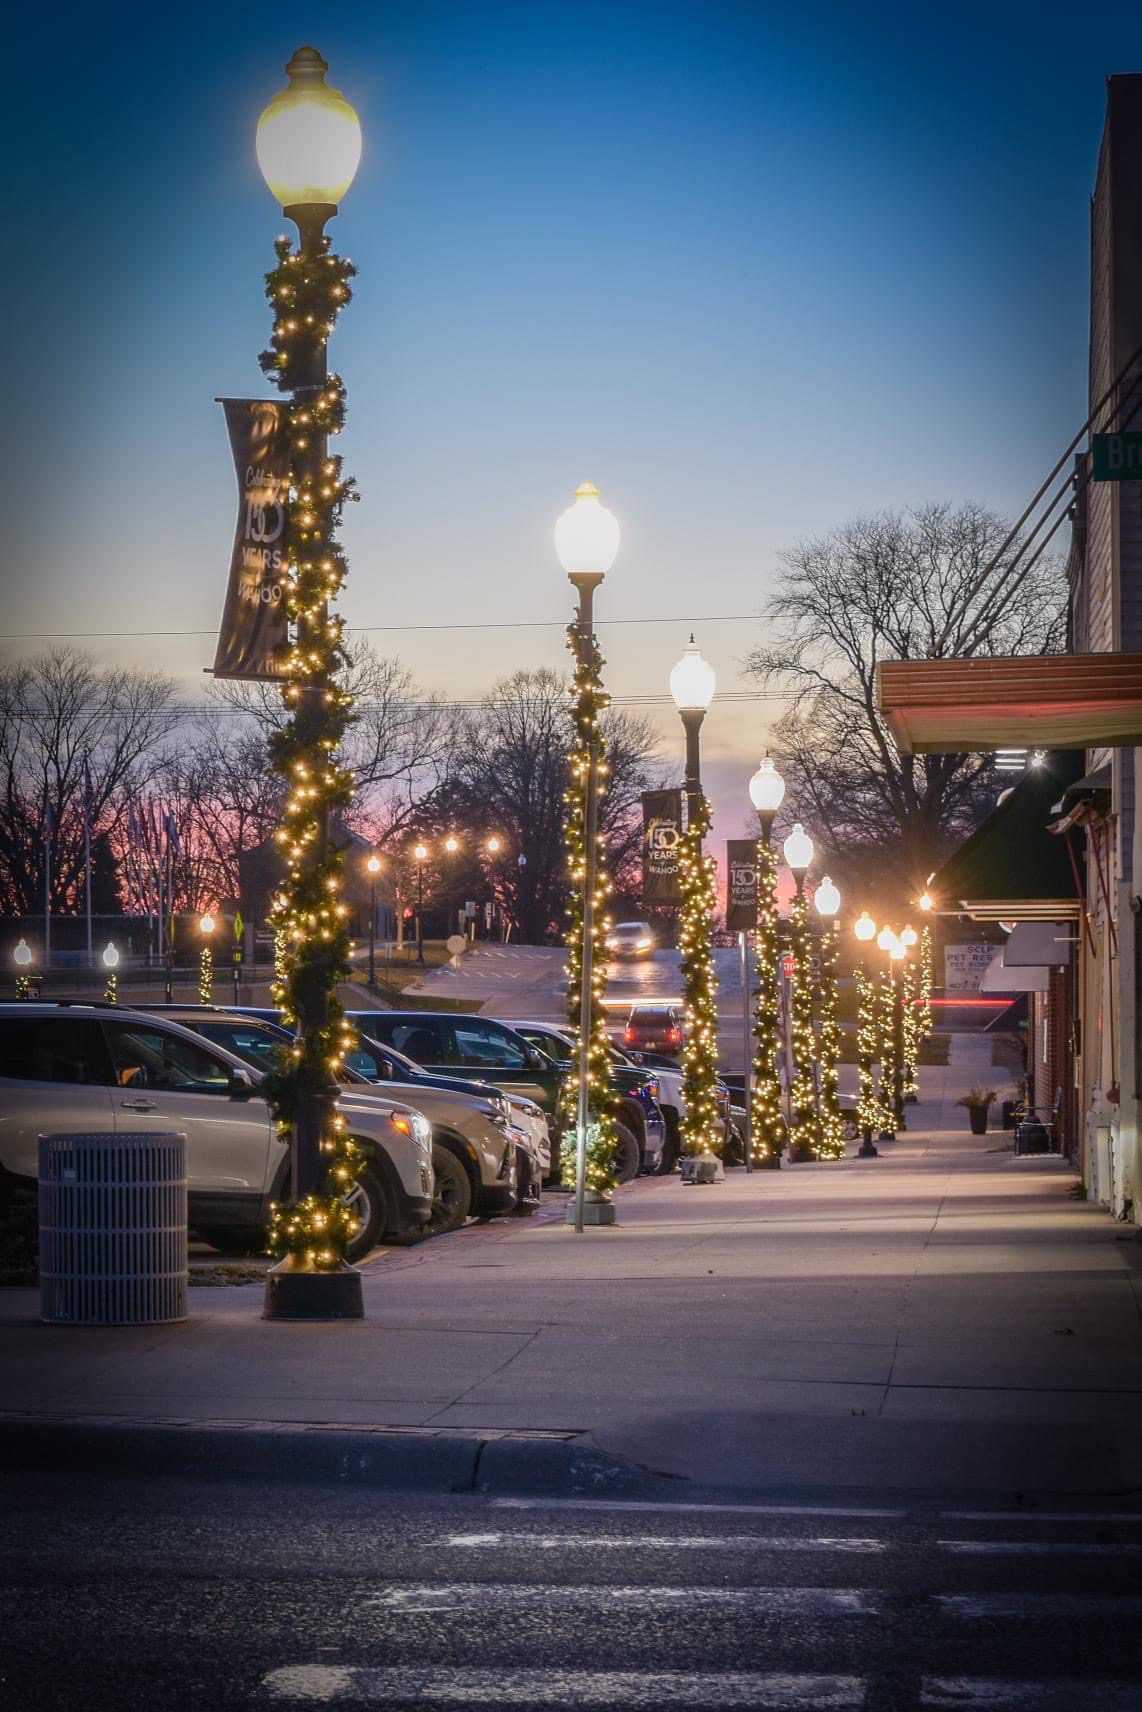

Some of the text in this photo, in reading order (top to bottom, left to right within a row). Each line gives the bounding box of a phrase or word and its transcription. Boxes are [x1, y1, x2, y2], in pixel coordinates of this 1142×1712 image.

[242, 547, 281, 569] YEARS
[648, 828, 680, 849] 150
[648, 851, 678, 860] YEARS
[649, 865, 679, 874] WAHOO
[731, 869, 756, 886] 150
